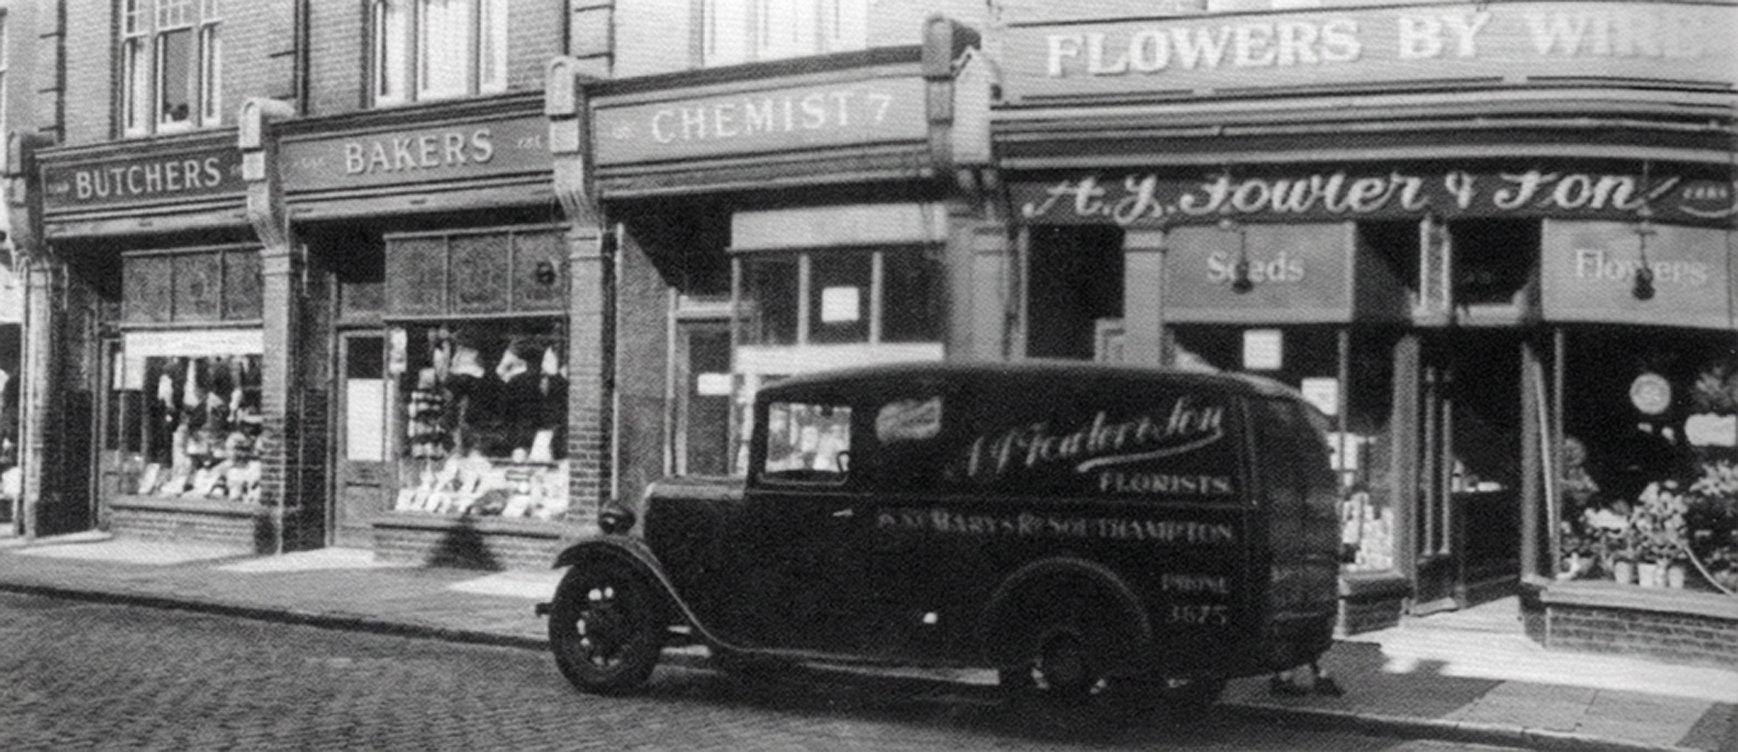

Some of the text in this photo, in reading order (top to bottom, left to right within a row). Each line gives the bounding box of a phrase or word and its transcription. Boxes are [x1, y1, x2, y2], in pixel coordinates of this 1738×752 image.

[1046, 14, 1362, 77] FLOWERS
[1398, 12, 1490, 61] BY
[651, 91, 853, 144] CHEMIST
[344, 127, 495, 175] BAKERS
[75, 156, 222, 199] BUTCHERS
[1180, 170, 1432, 214] Fowler
[1444, 172, 1476, 210] &
[1493, 169, 1660, 211] Son
